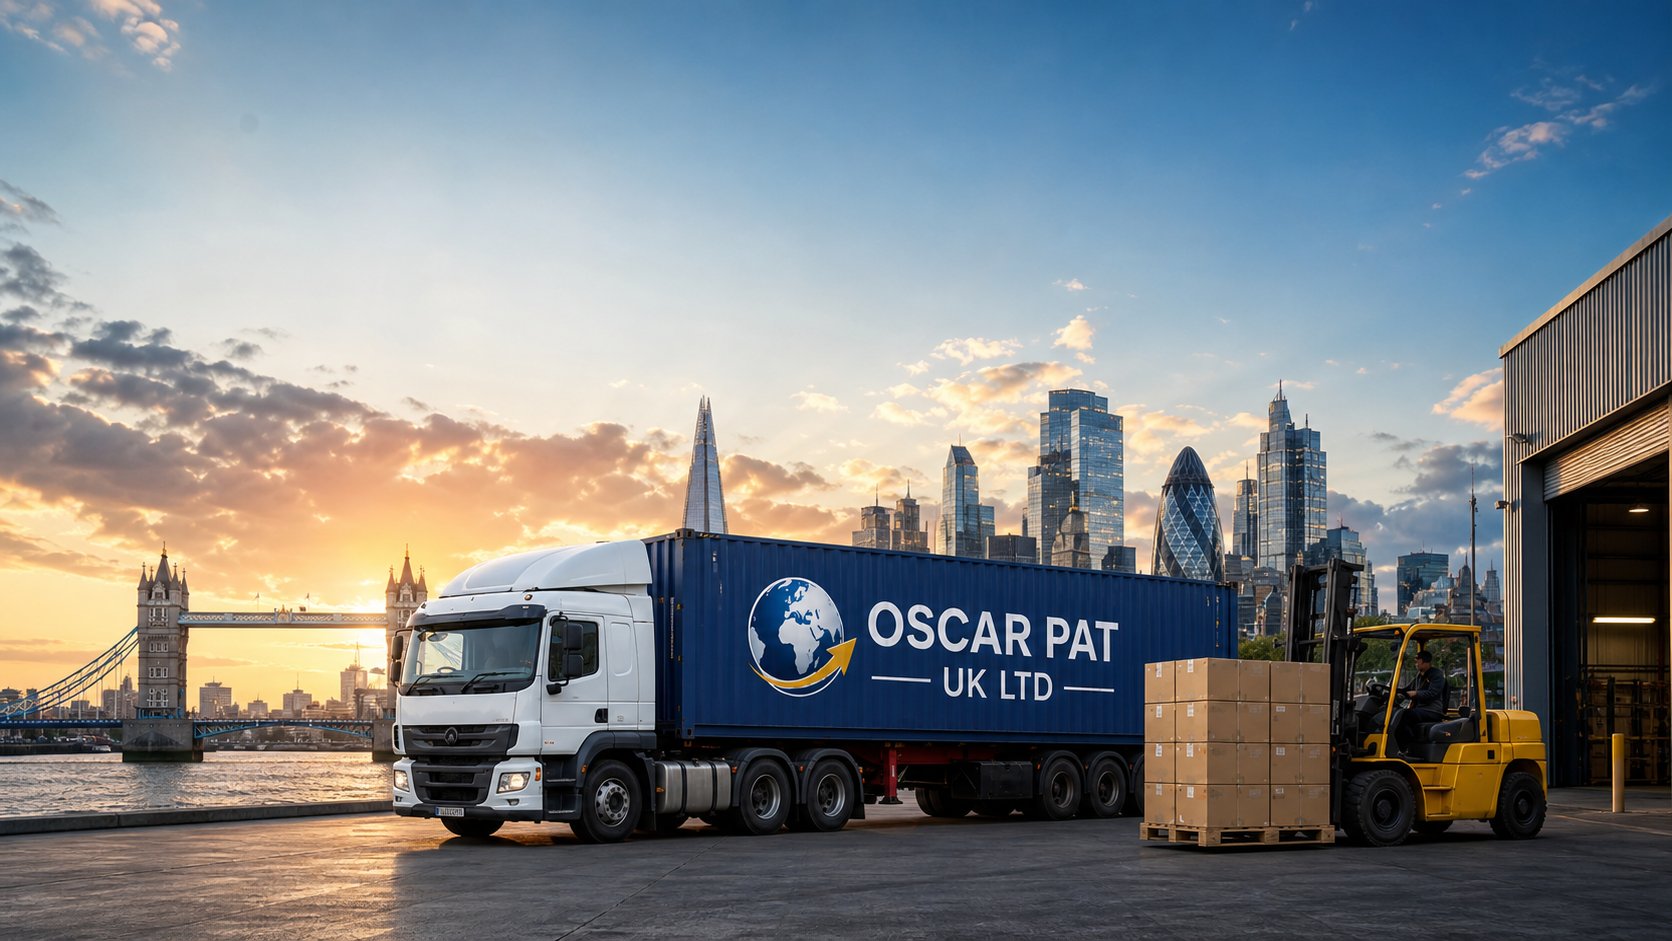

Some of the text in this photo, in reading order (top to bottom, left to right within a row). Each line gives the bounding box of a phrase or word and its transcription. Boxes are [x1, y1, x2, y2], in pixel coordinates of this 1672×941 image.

[868, 601, 1119, 662] OSCAR PAT
[944, 666, 1053, 701] UK LTD
